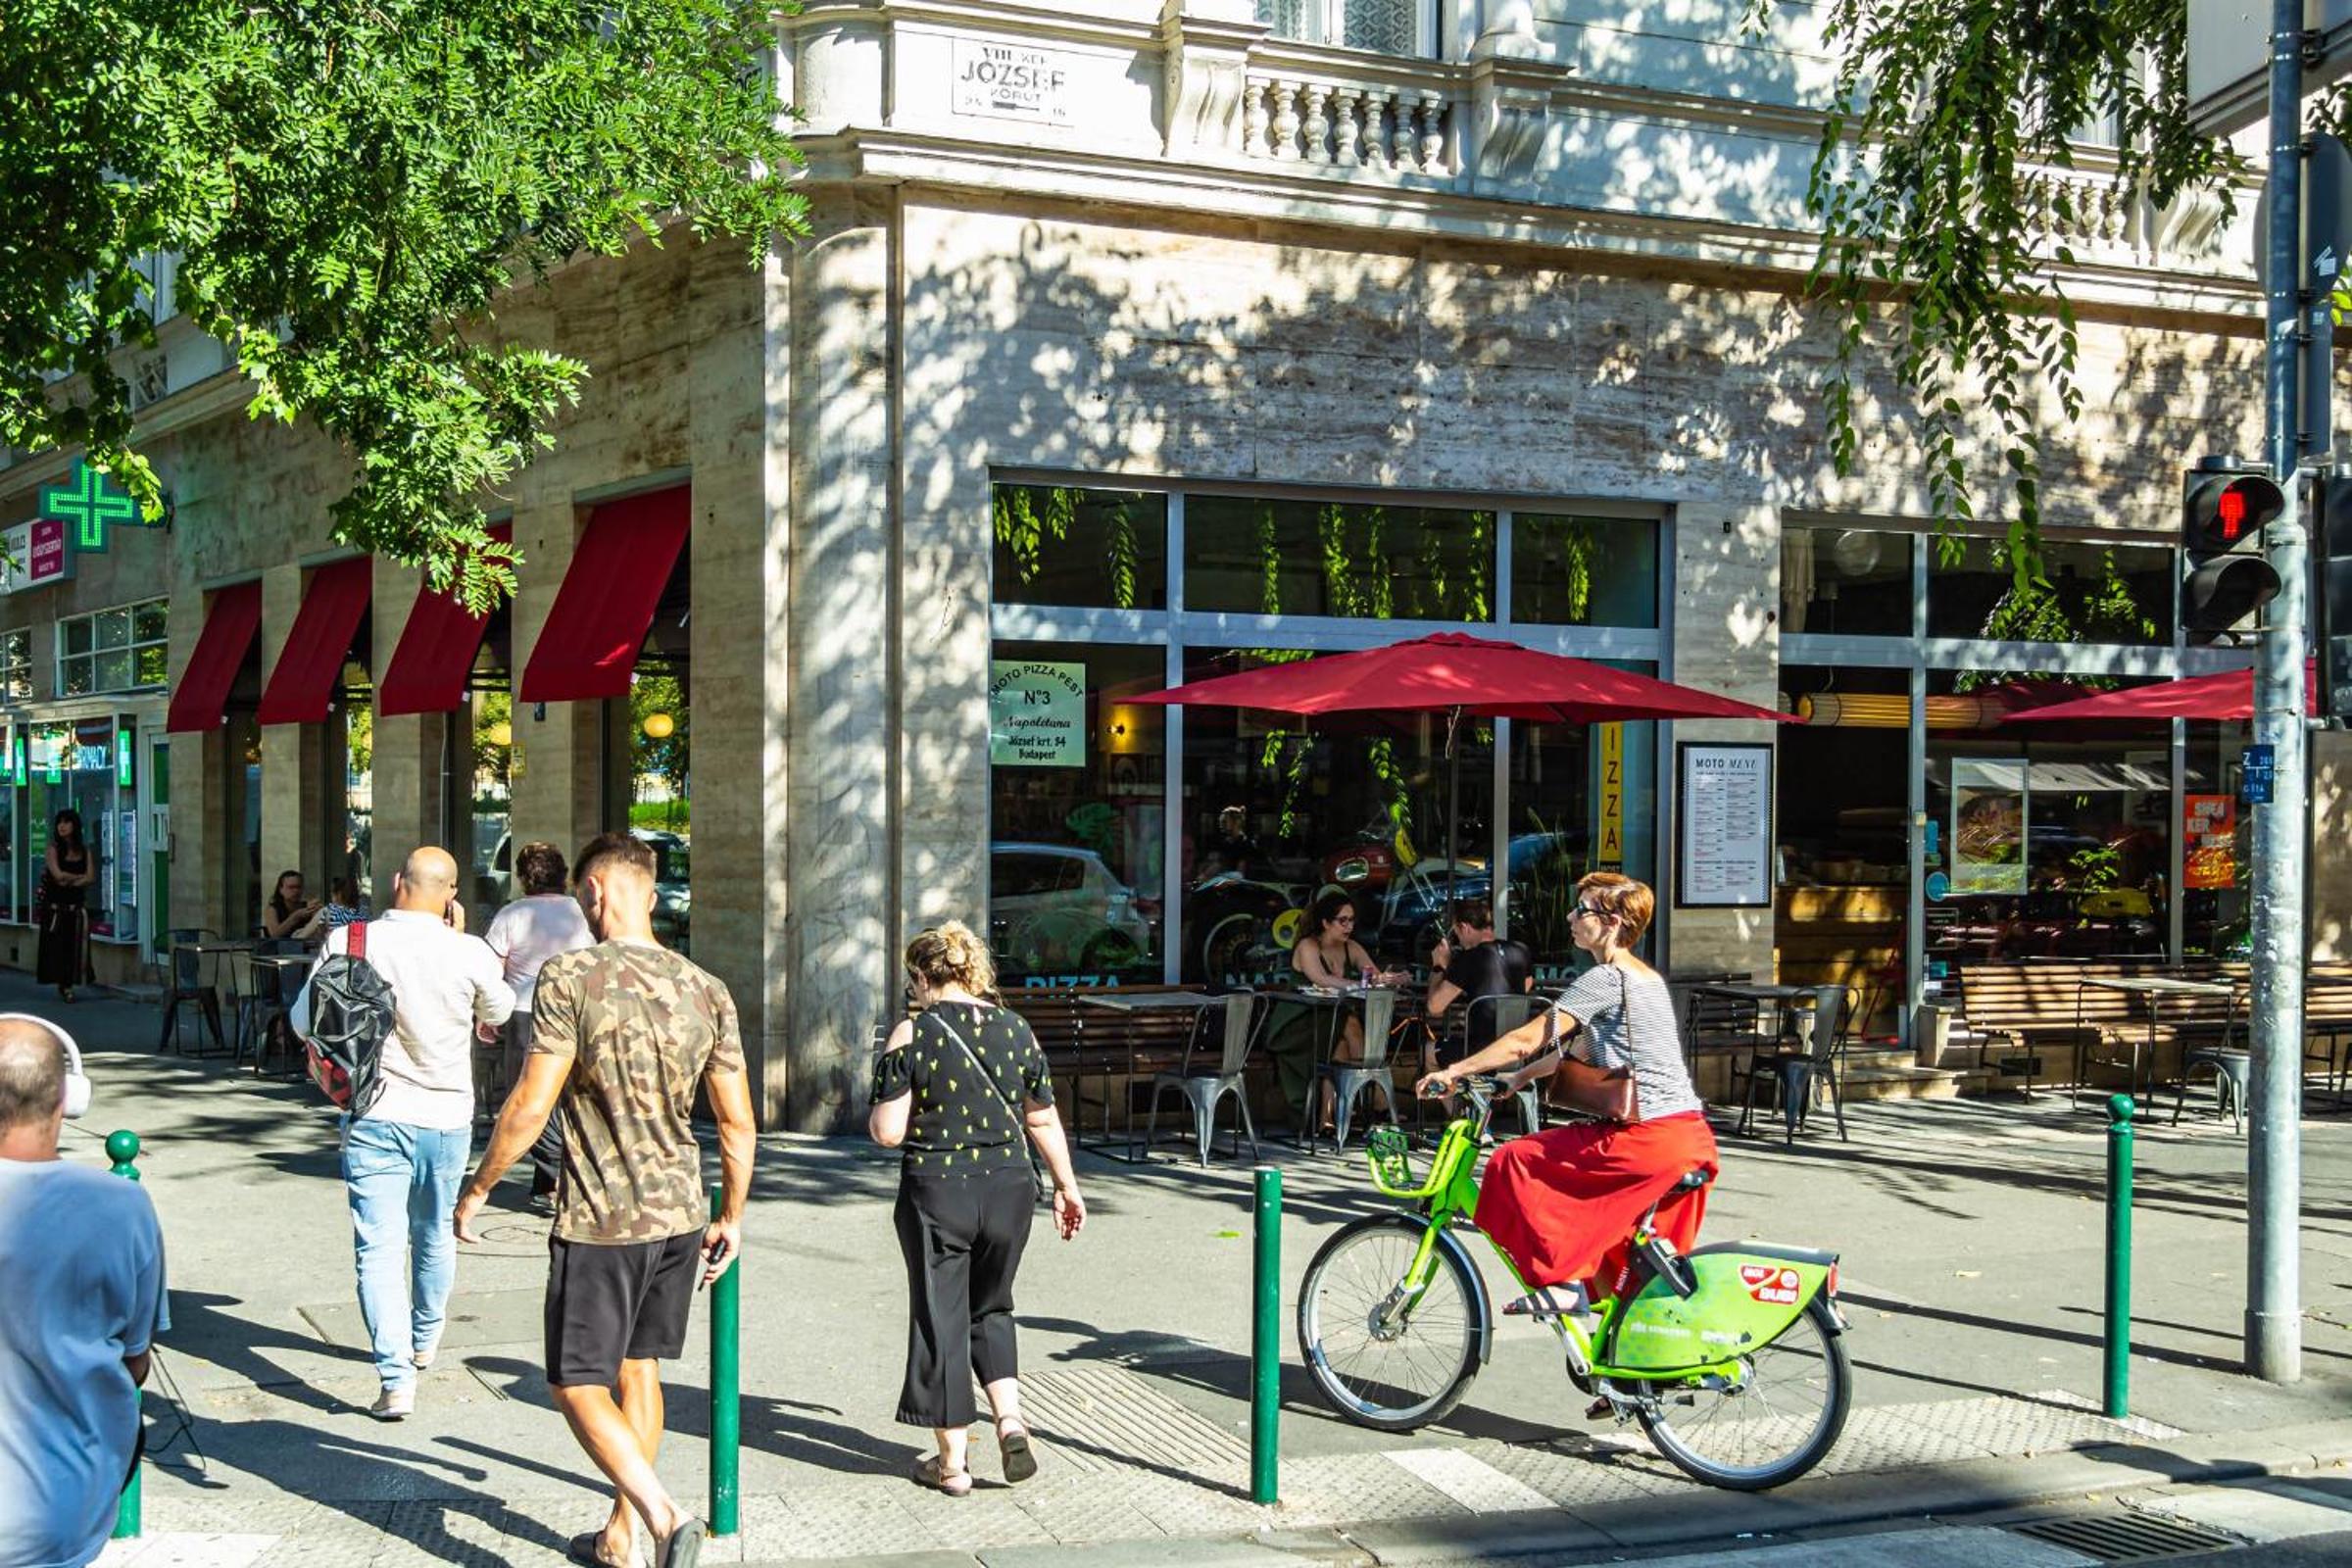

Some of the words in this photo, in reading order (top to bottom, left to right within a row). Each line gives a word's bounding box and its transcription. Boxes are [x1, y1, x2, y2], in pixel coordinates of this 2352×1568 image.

[991, 668, 1021, 696] MOTO
[1023, 663, 1056, 677] PIZZA
[1057, 671, 1084, 698] PEST
[1695, 758, 1725, 768] MOTO
[1605, 727, 1619, 851] IZZA
